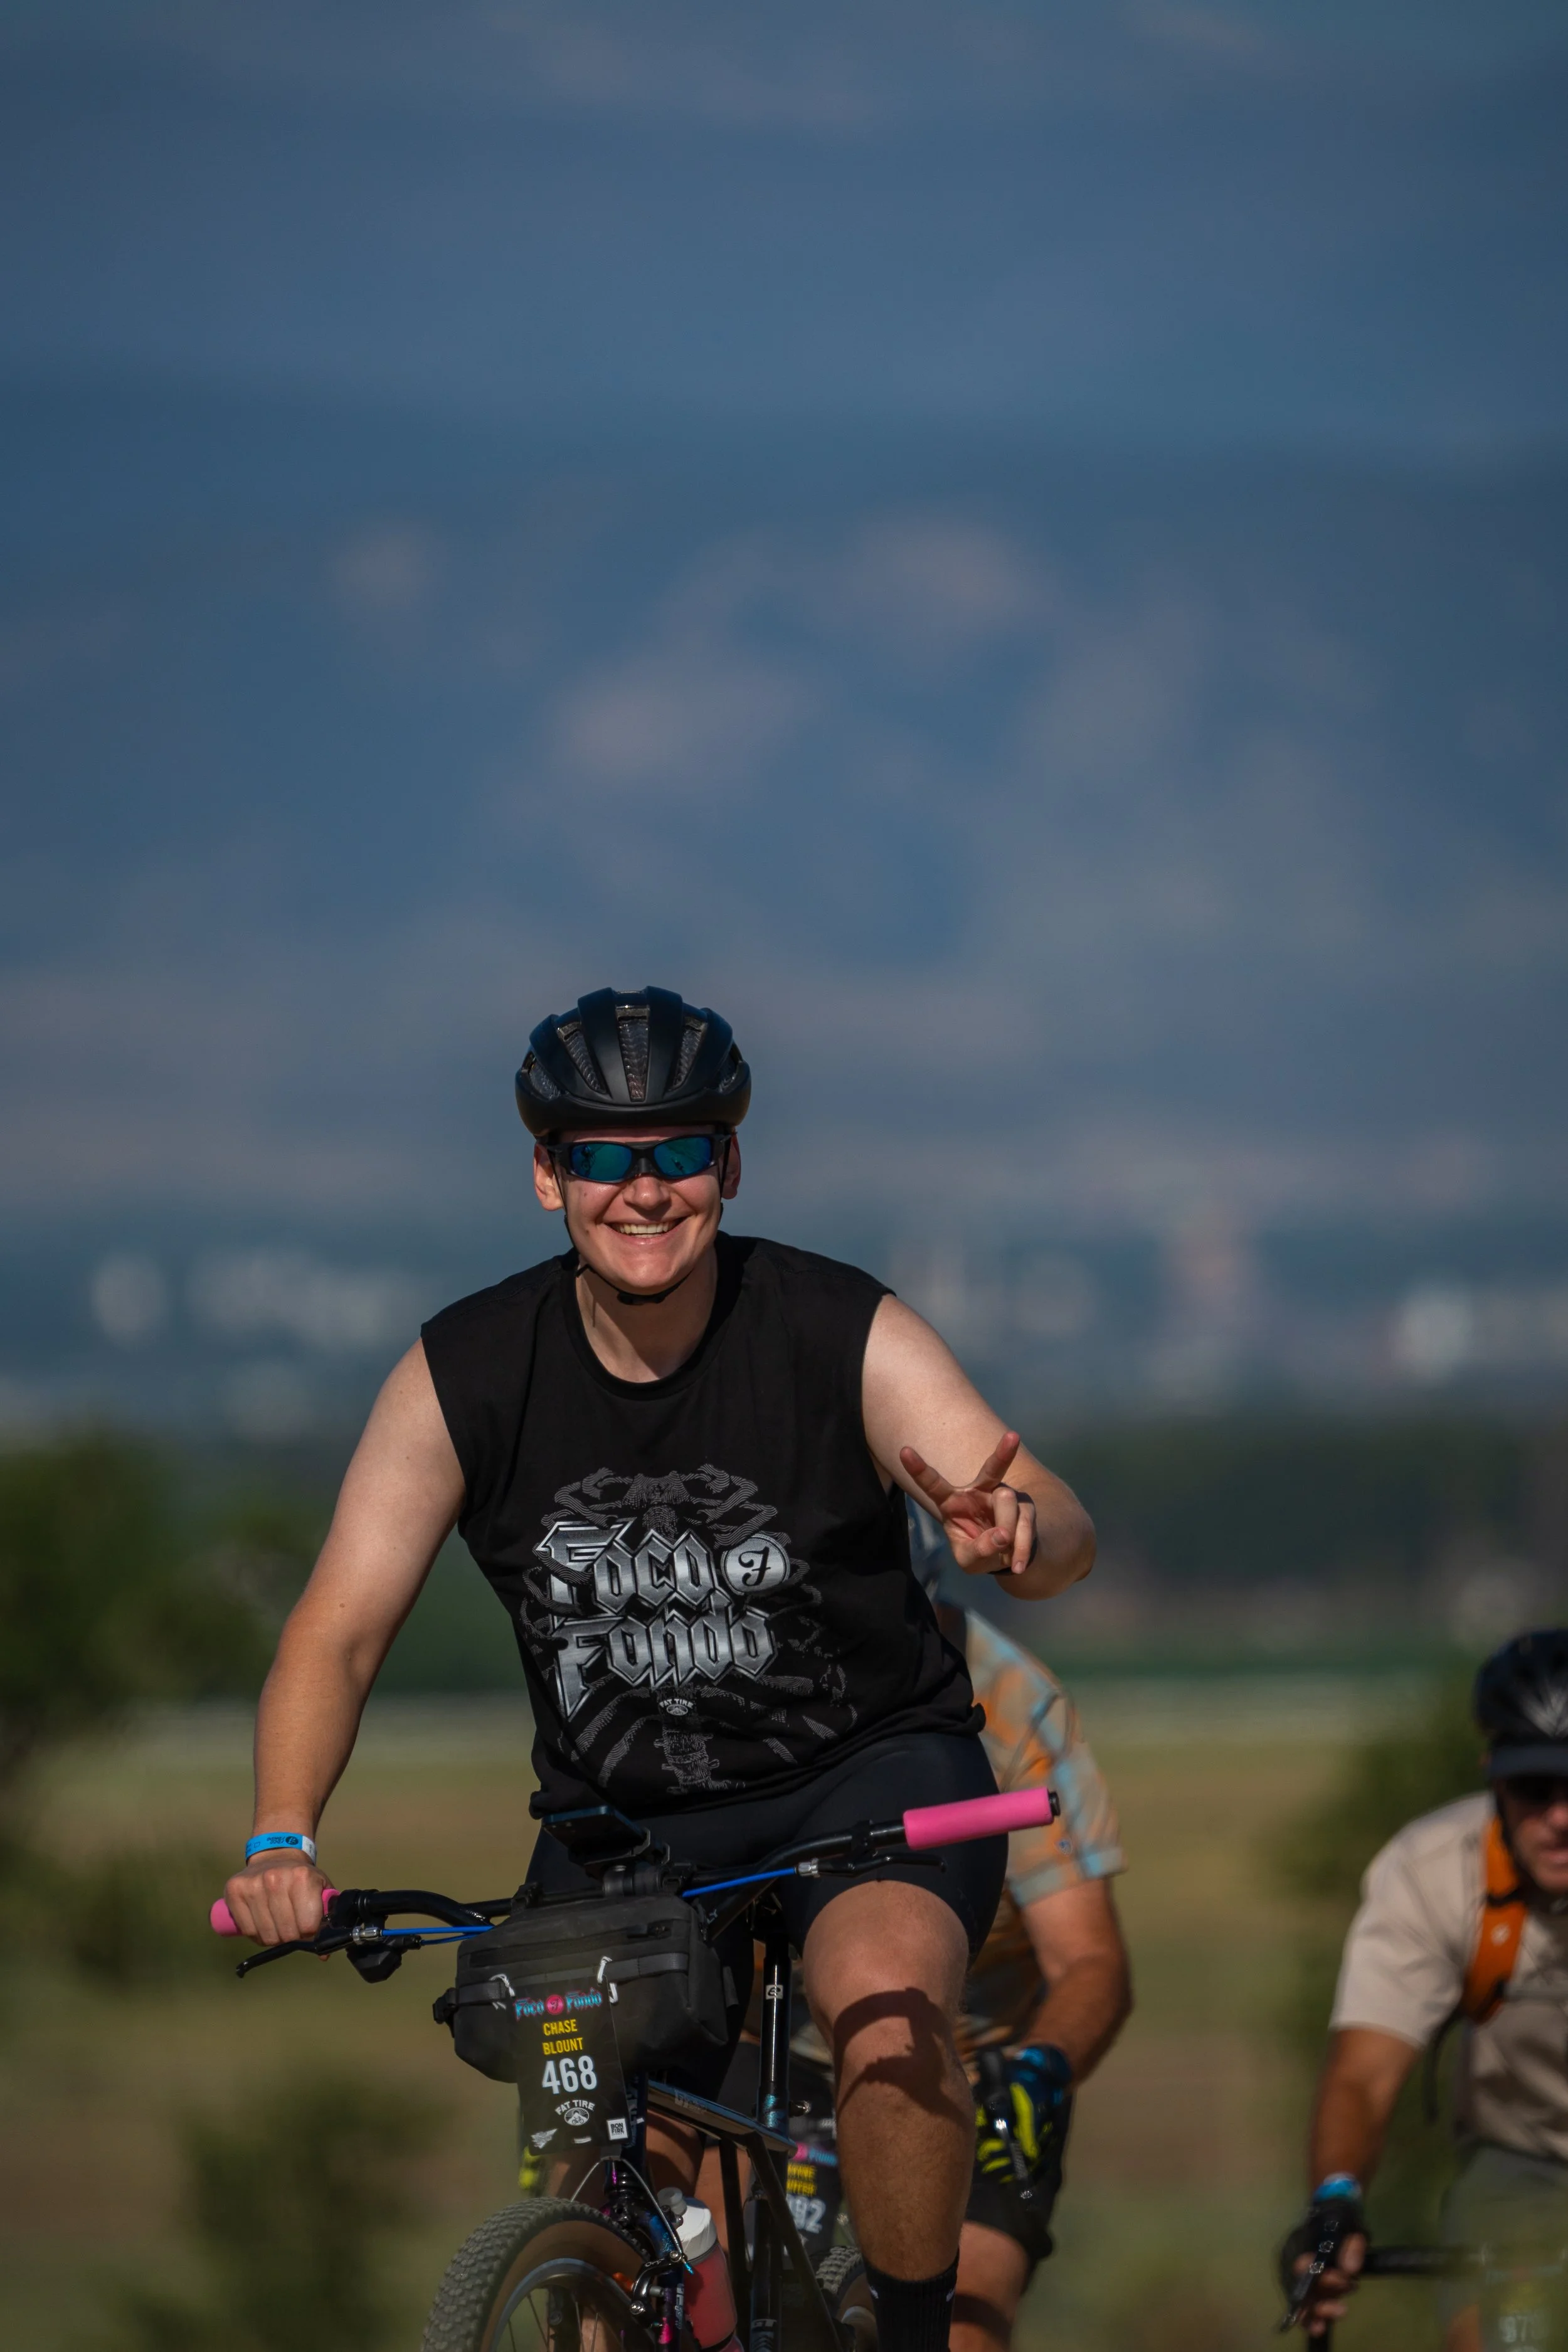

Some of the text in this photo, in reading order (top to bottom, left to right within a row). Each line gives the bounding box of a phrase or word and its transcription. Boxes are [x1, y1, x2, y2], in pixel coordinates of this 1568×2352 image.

[659, 1698, 694, 1709] FAT TIRE
[543, 2019, 578, 2037] CHASE
[542, 2037, 583, 2055] BLOUNT
[542, 2055, 597, 2094] 468
[554, 2099, 595, 2116] FAT TIRE
